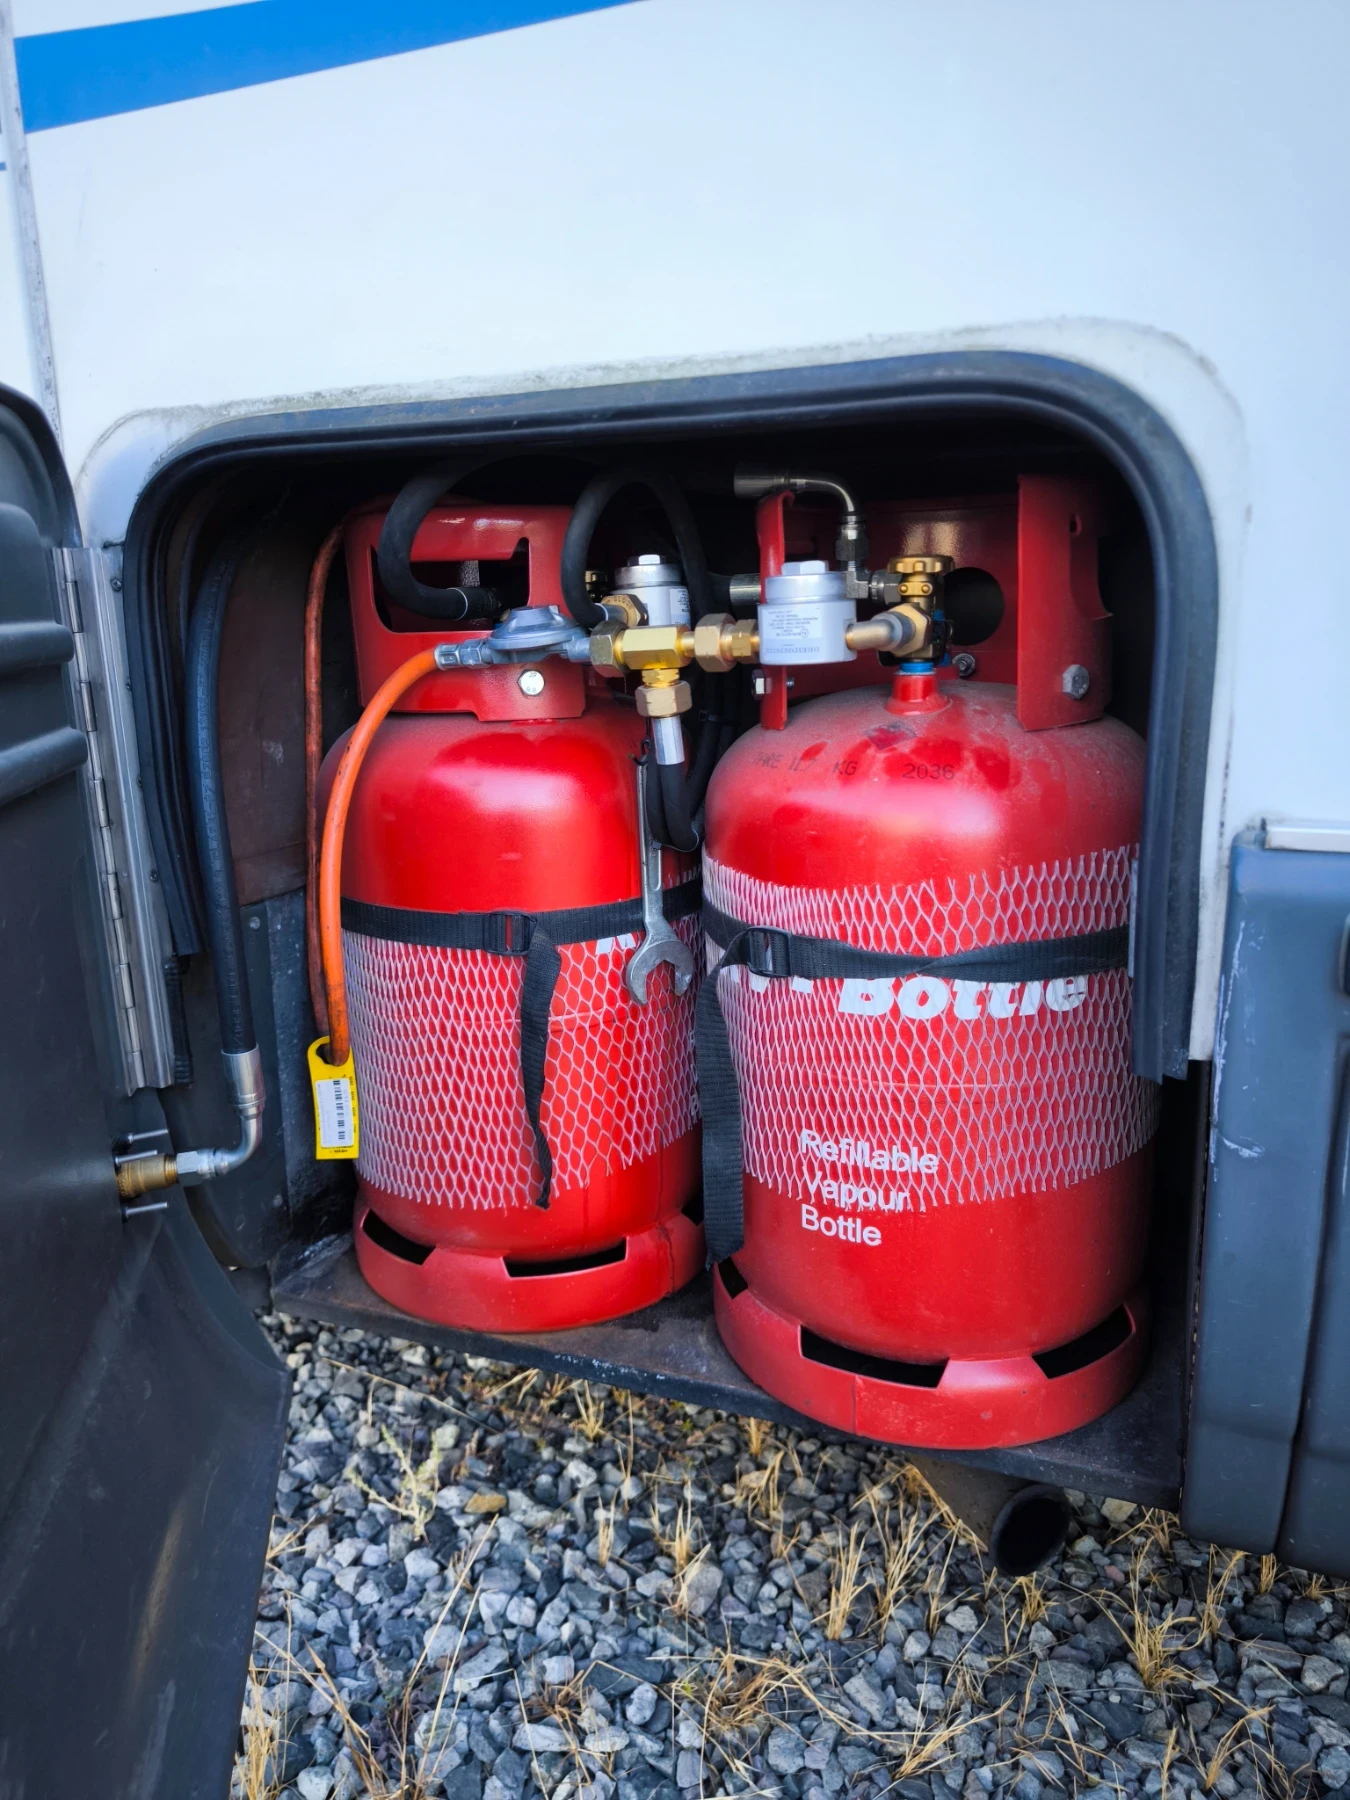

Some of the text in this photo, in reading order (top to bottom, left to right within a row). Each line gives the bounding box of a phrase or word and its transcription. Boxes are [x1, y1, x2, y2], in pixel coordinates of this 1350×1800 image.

[765, 646, 820, 654] DREHMEIS
[832, 760, 858, 776] KG
[902, 763, 955, 780] 2036
[801, 1128, 939, 1174] Refillable
[802, 1166, 910, 1210] Vapour
[801, 1203, 882, 1246] Bottle
